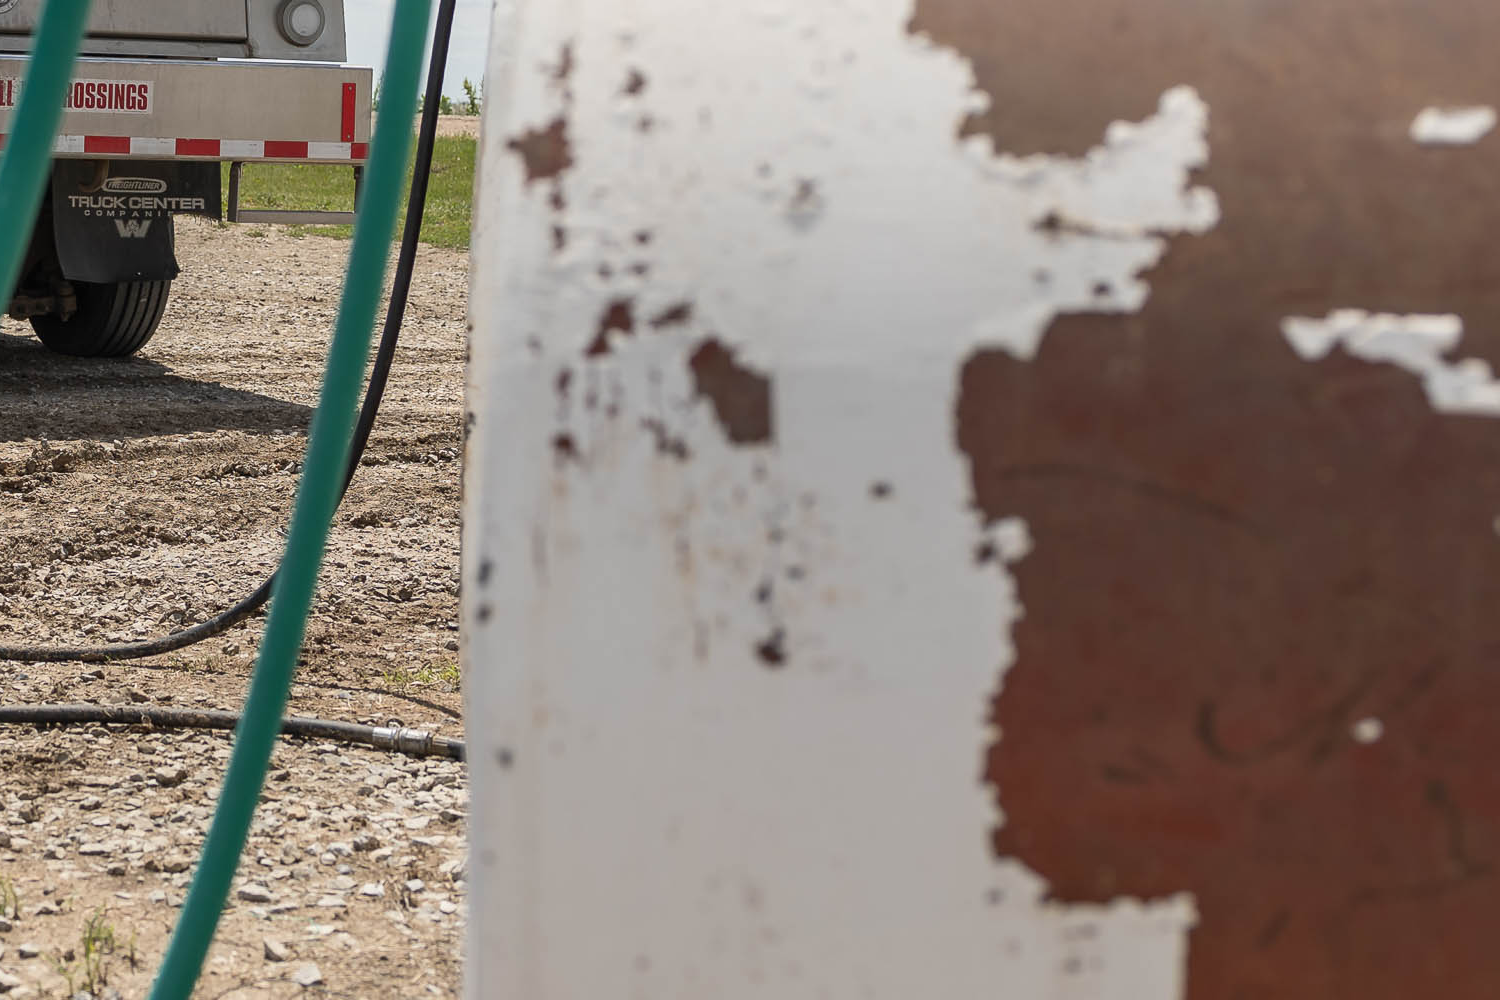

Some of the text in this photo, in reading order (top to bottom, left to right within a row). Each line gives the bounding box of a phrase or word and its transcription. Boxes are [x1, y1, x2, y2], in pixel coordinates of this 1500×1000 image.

[64, 82, 148, 110] ROSSINGS
[108, 181, 160, 190] FREIGHTLINER
[68, 196, 204, 209] TRUCK CENTER
